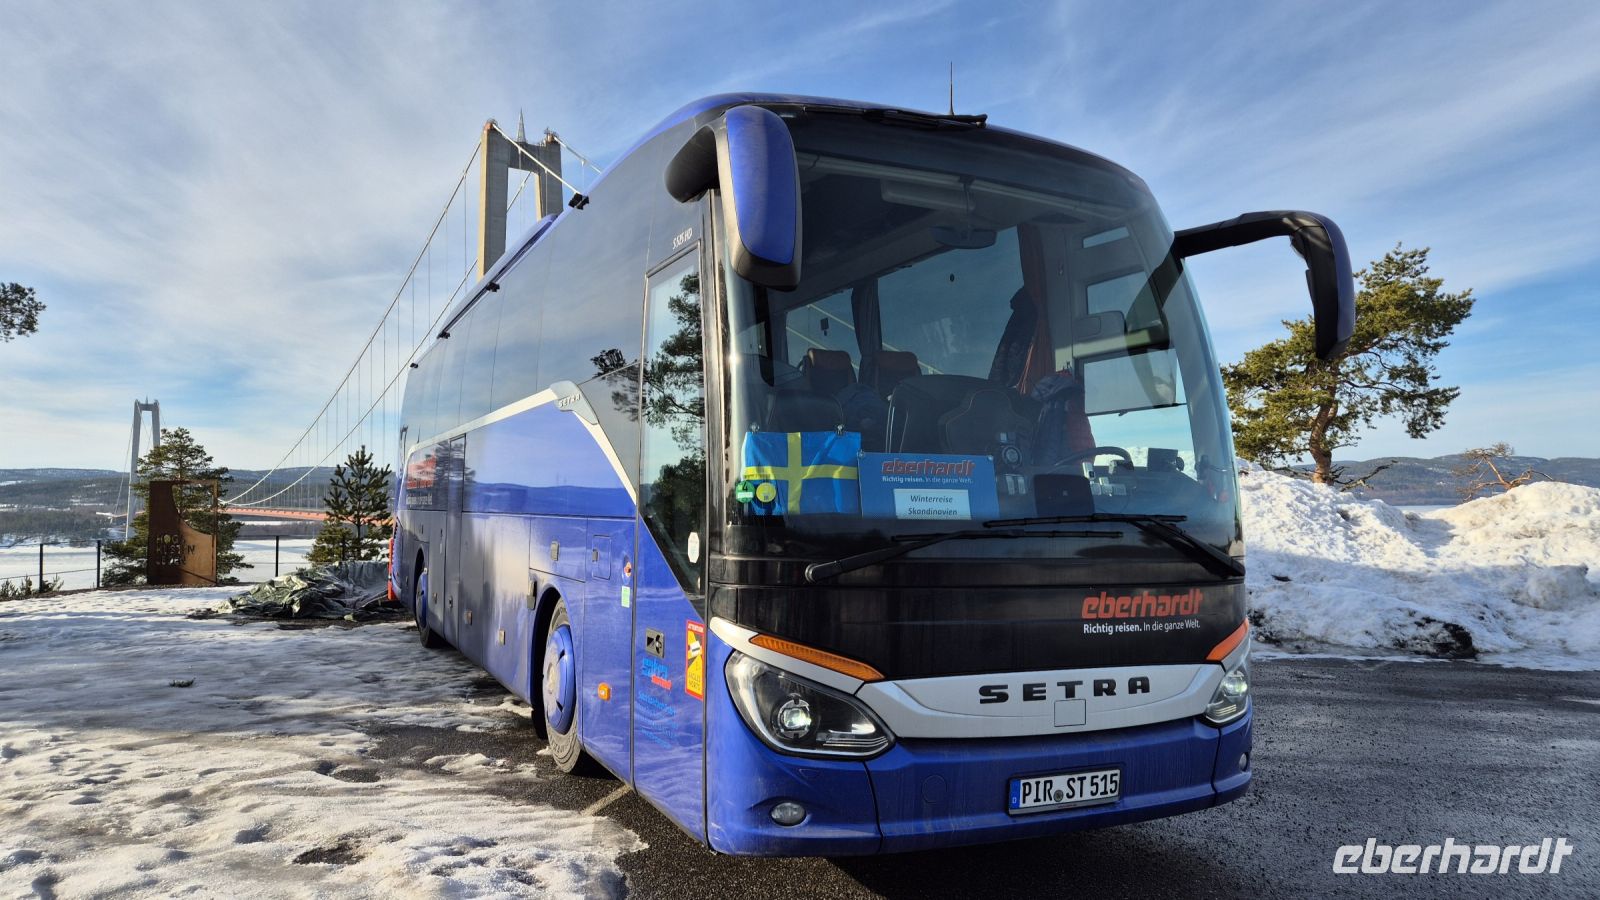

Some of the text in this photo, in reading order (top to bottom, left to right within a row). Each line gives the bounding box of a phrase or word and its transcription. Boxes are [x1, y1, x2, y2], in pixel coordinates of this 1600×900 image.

[881, 458, 976, 476] eberhardt
[882, 476, 904, 484] Richtig
[910, 495, 953, 503] Winterreise
[908, 507, 958, 516] Skandinavien
[1081, 588, 1204, 619] eberhardt
[1083, 619, 1201, 635] Richtig reisen. In die ganze Welt.
[978, 676, 1150, 704] SETRA
[1021, 773, 1118, 804] PIR ST 515
